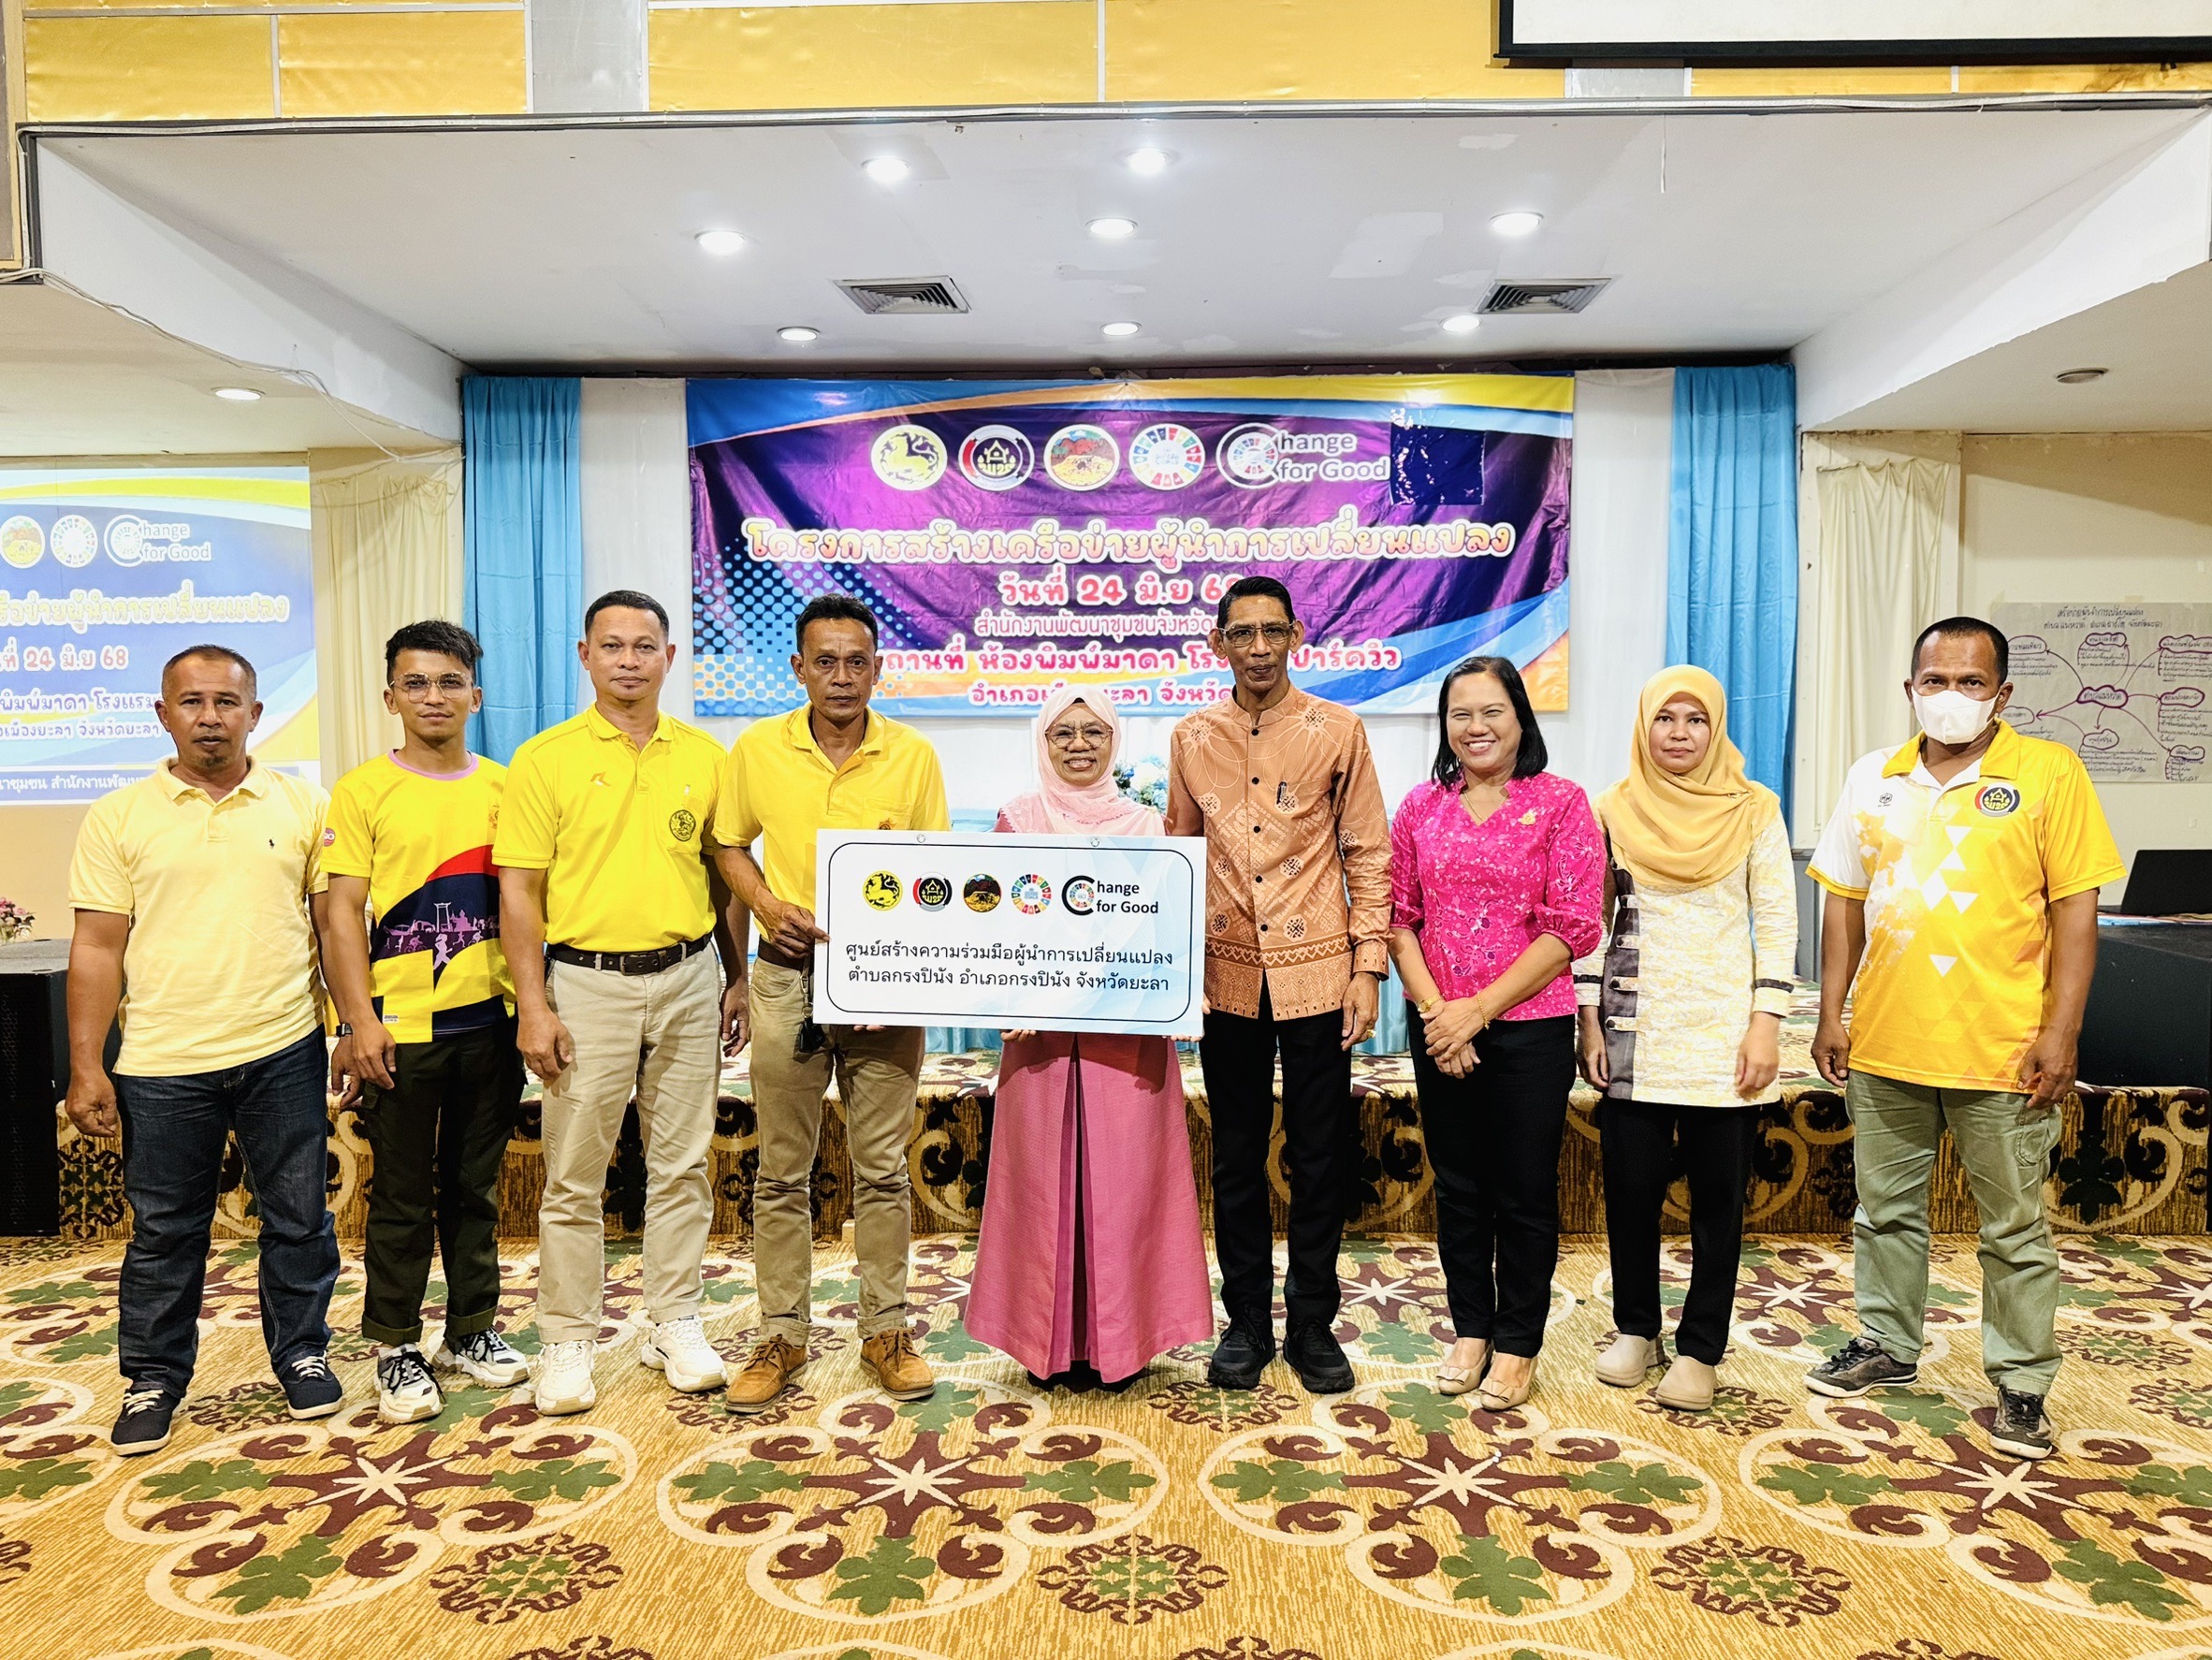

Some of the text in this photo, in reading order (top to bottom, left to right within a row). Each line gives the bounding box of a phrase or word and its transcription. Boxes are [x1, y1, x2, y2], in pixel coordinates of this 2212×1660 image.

[1280, 459, 1387, 480] for Good
[745, 507, 1512, 569] โครงการสร้างเครือข่ายผู้นำการเปลี่ยนแปลง
[143, 545, 211, 560] for Good
[1000, 565, 1065, 603] วันที่
[1080, 577, 1125, 602] 24
[1138, 575, 1189, 602] มิ.ย
[976, 611, 1217, 640] สำนักงานพัฒนาชุมชนจังหวัด
[0, 639, 127, 668] ที่ 24 มิ.ย 68
[883, 636, 966, 671] ถานที่
[978, 644, 1175, 671] ห้องพิมพ์มาดา
[1158, 680, 1233, 703] จังหวัด
[0, 720, 160, 737] เมืองยะลา จังหวัดยะลา
[1096, 899, 1159, 914] for Good
[845, 939, 1174, 967] ศูนย์สร้างความร่วมมือผู้นำการเปลี่ยนแปลง
[848, 967, 1170, 992] ตำบลกรงปินัง อำเภอกรงปินัง จังหวัดยะลา
